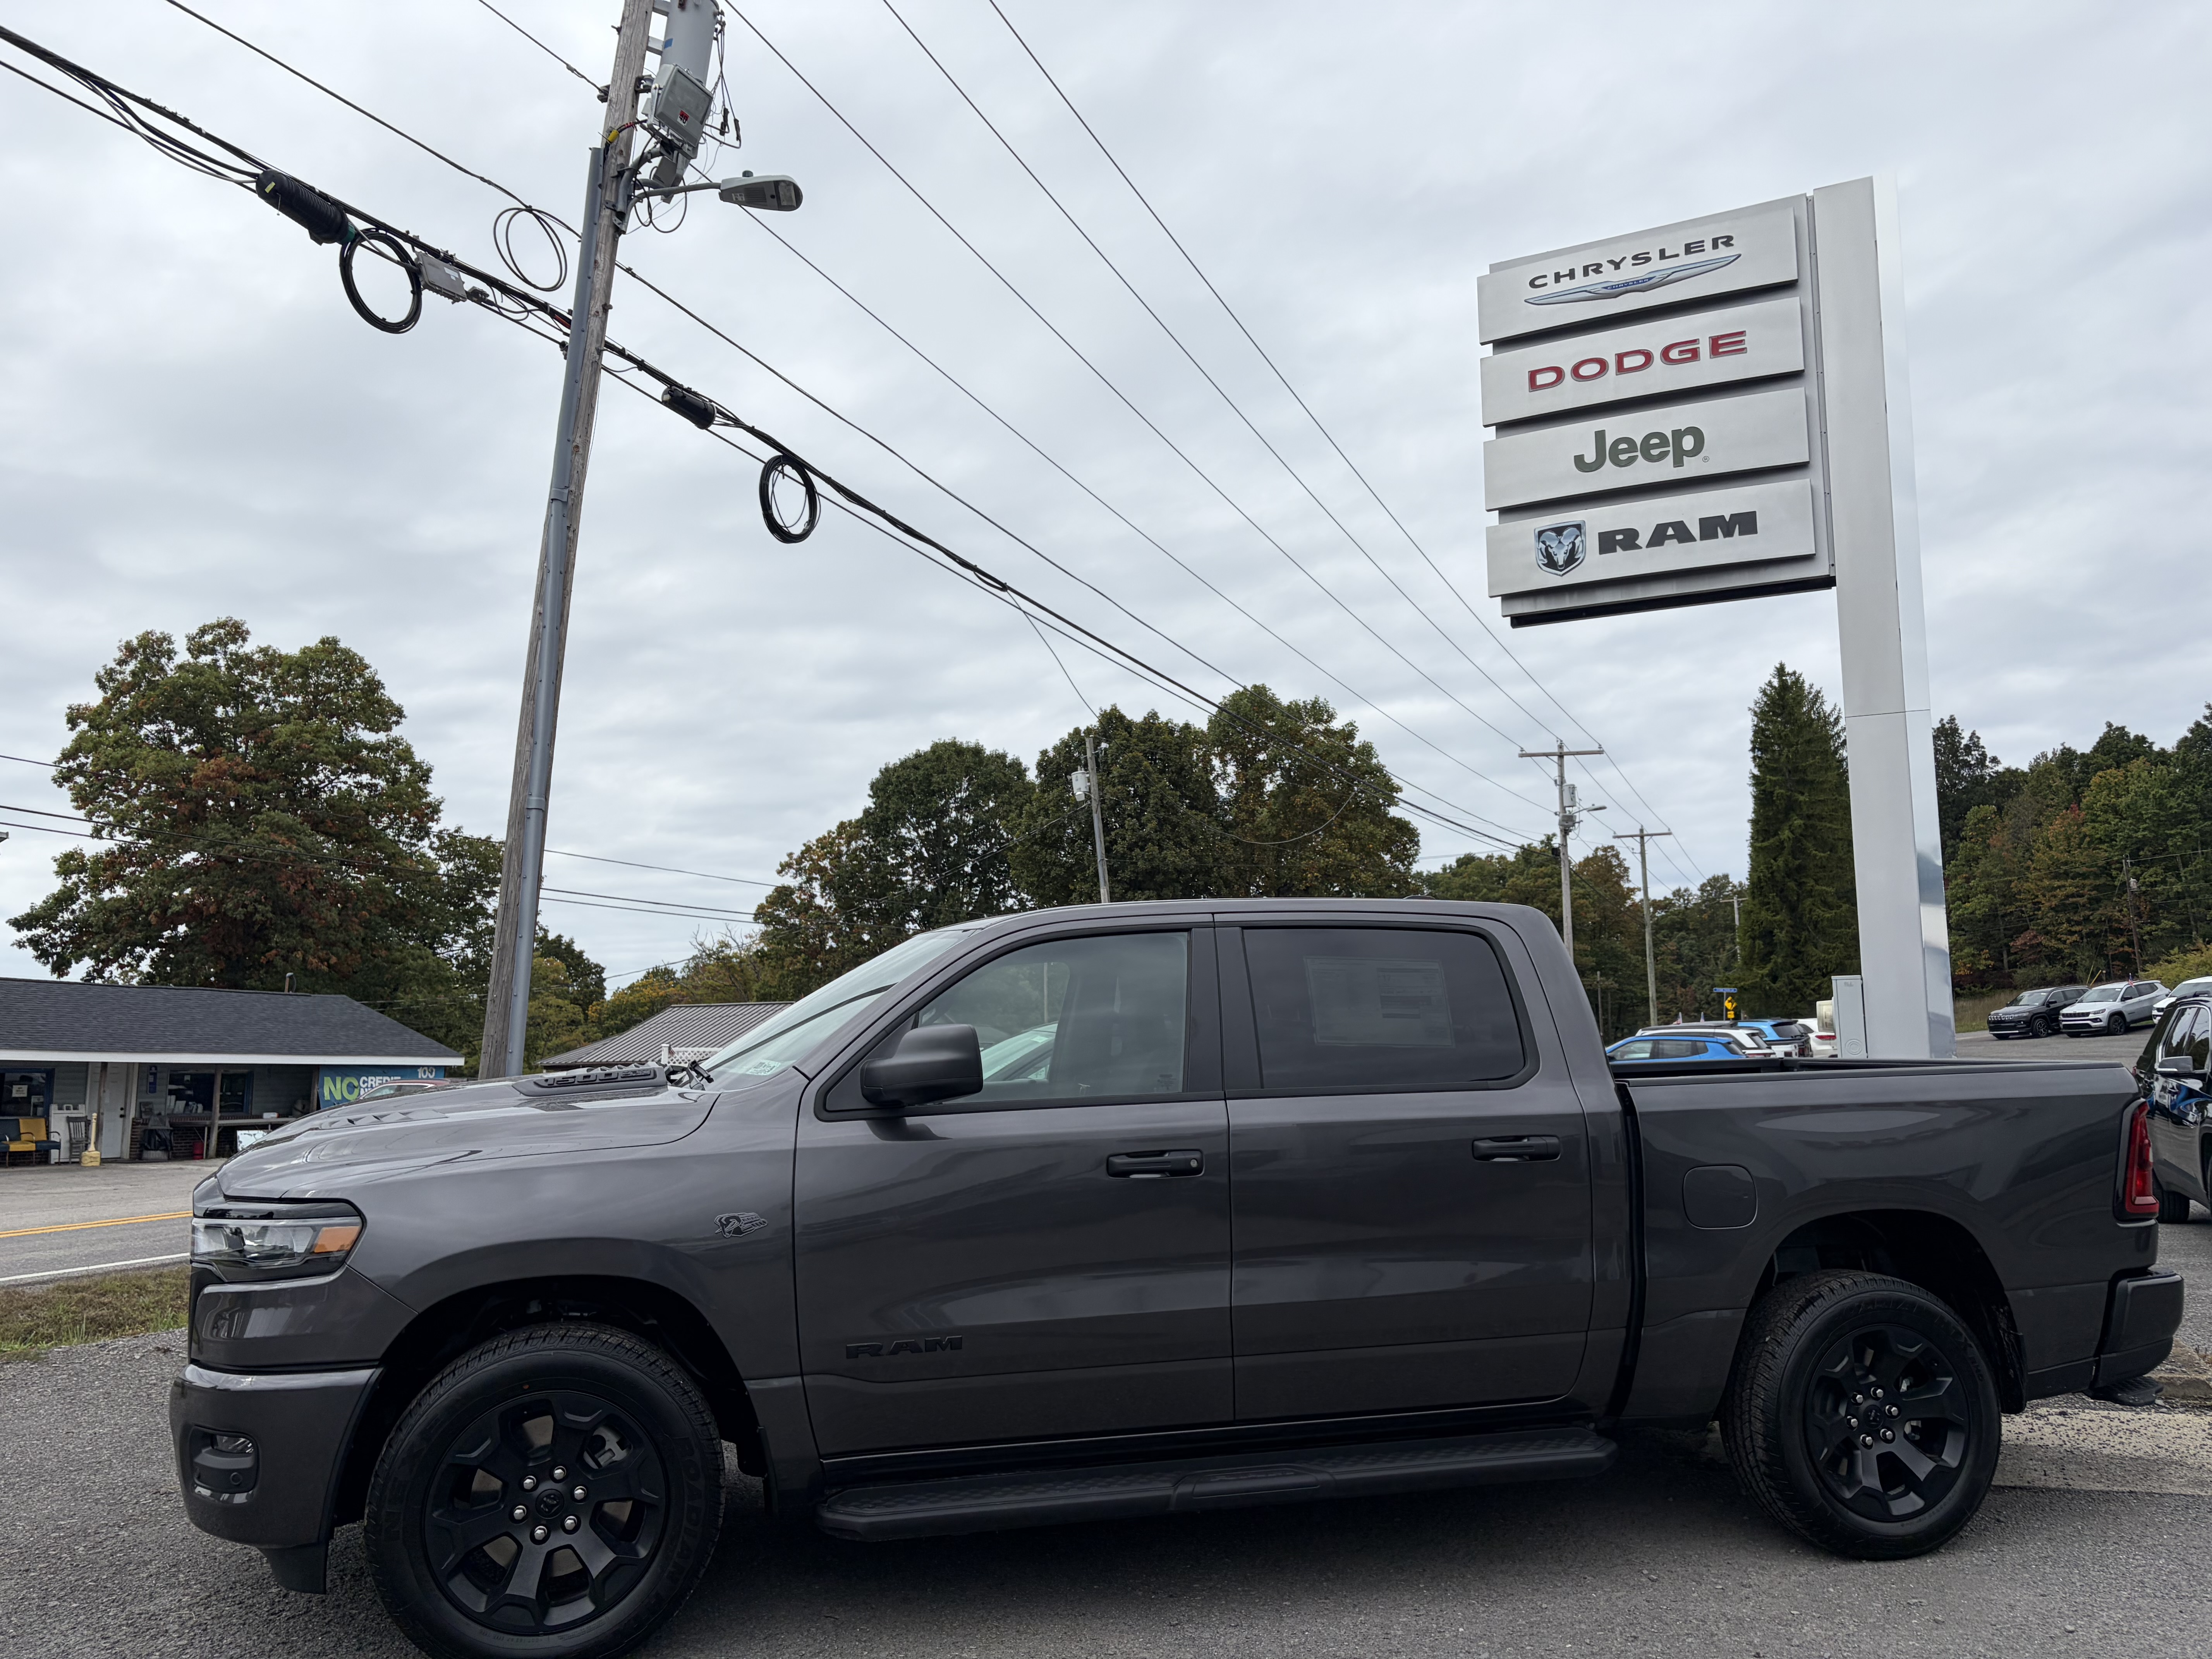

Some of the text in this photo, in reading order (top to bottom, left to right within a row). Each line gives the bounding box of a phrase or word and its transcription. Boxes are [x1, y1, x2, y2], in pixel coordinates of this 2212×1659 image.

[1529, 235, 1734, 289] CHRYSLER
[1528, 330, 1748, 392] DODGE
[1573, 426, 1705, 473] Jeep
[1598, 511, 1758, 555] RAM
[324, 1077, 360, 1101] NO
[846, 1335, 962, 1359] RAM
